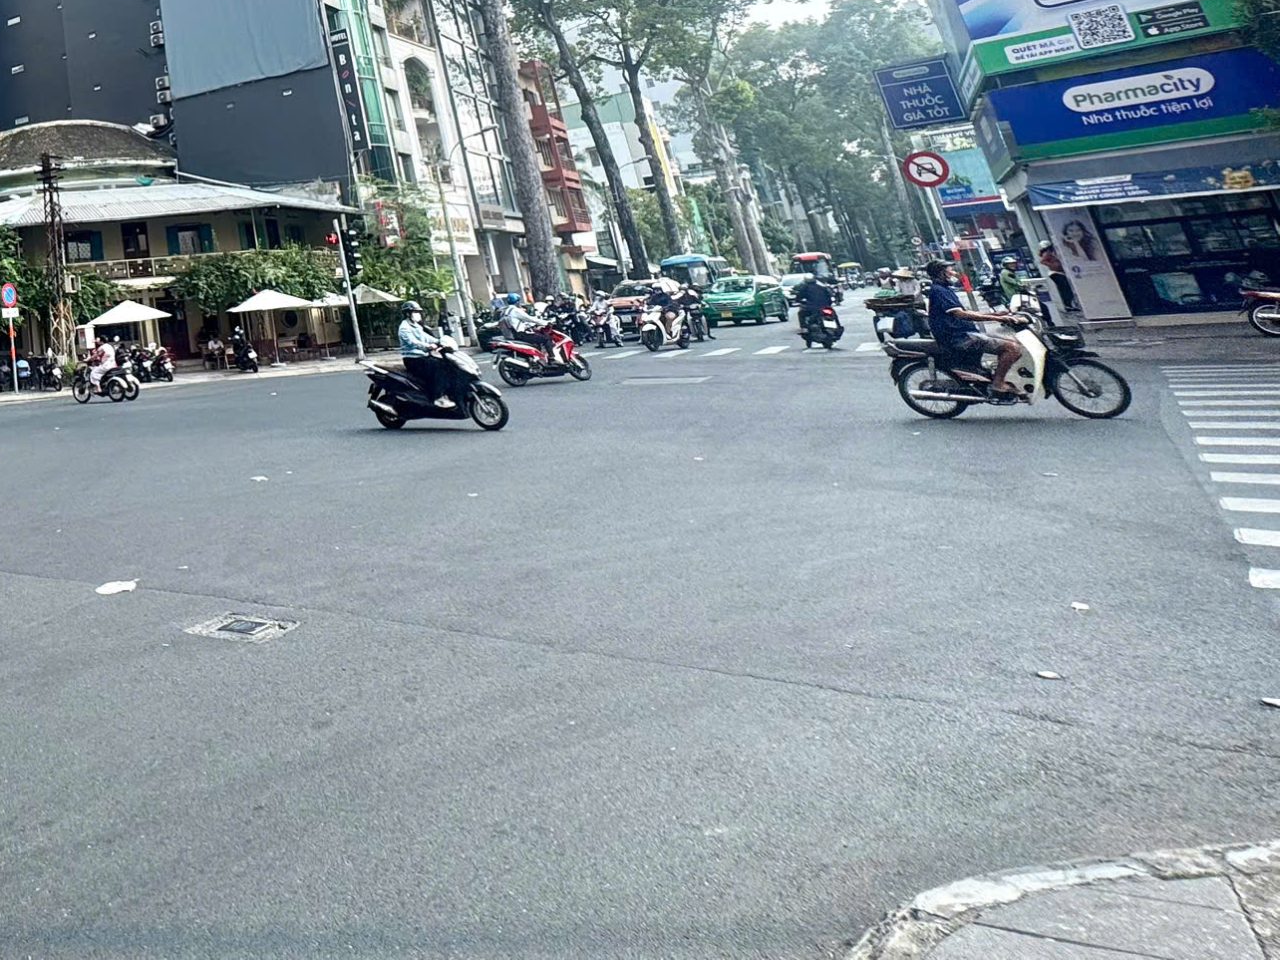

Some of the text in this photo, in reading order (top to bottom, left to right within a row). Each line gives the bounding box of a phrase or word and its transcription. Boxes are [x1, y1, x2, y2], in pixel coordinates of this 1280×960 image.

[1011, 43, 1037, 54] QUÉT
[903, 83, 932, 97] NHÀ
[1073, 75, 1202, 108] Pharmacity
[900, 93, 945, 109] THUỐC
[903, 106, 950, 122] GIÁ TỐT
[1081, 96, 1214, 125] Nhà thuốc tiện lợi
